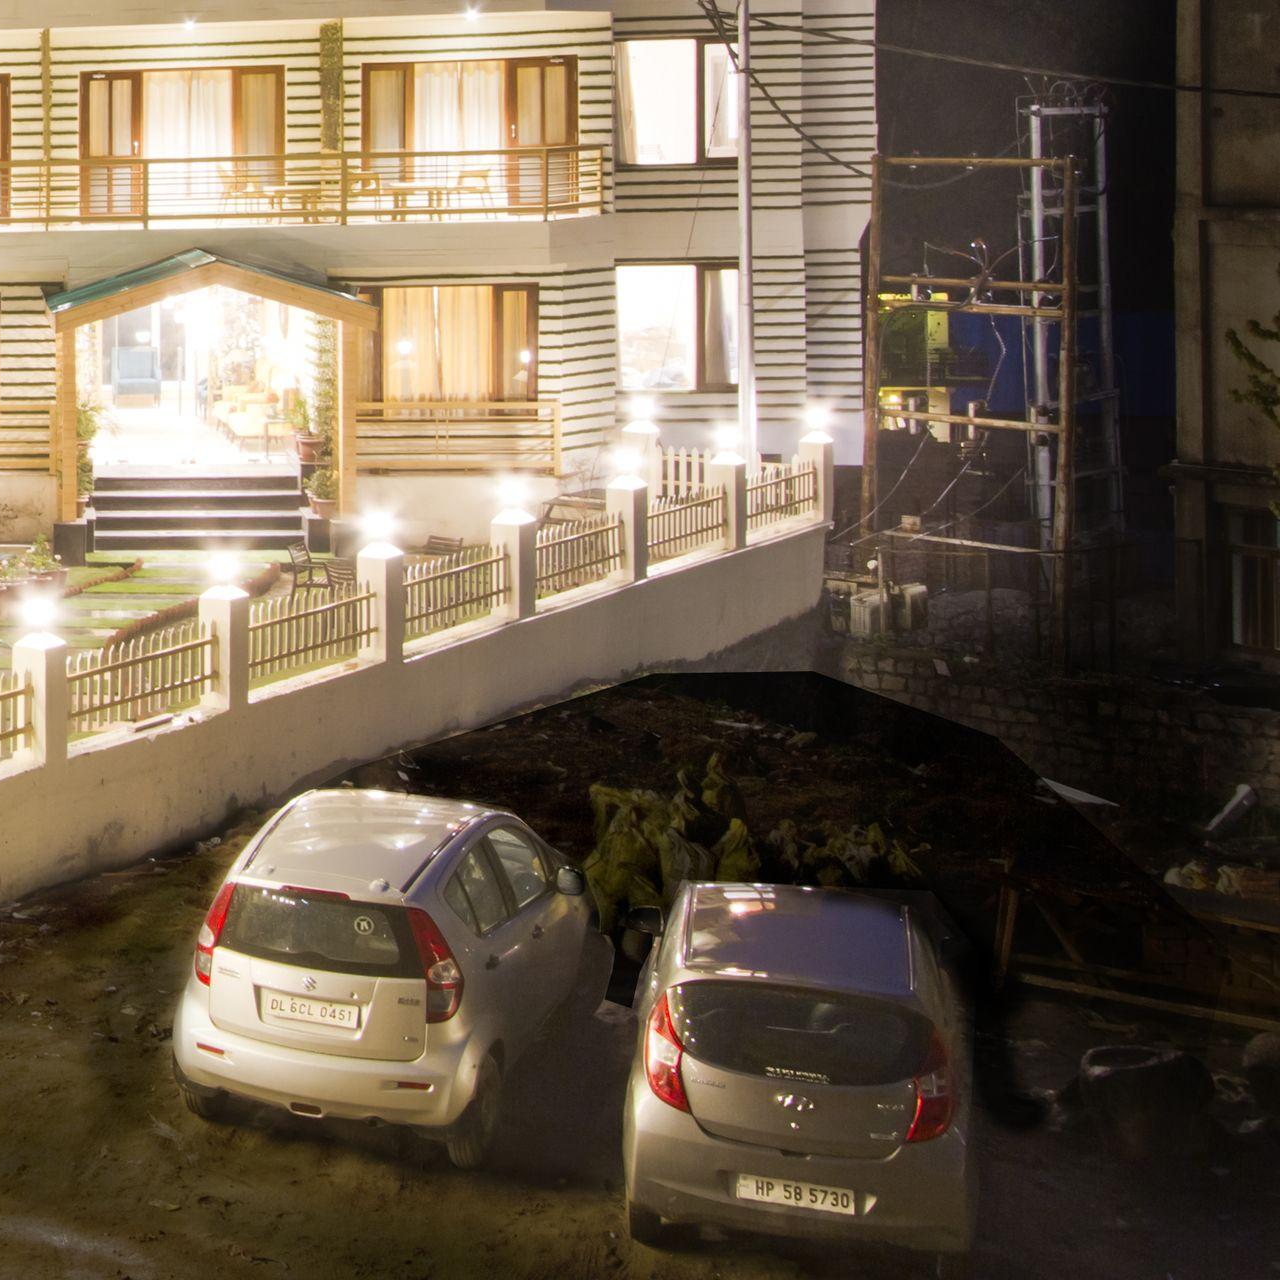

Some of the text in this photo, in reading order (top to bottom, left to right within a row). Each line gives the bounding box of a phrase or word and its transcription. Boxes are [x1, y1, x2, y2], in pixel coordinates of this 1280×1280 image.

[270, 998, 352, 1022] DL 6CL 0451
[754, 1179, 850, 1209] HP 58 5730
